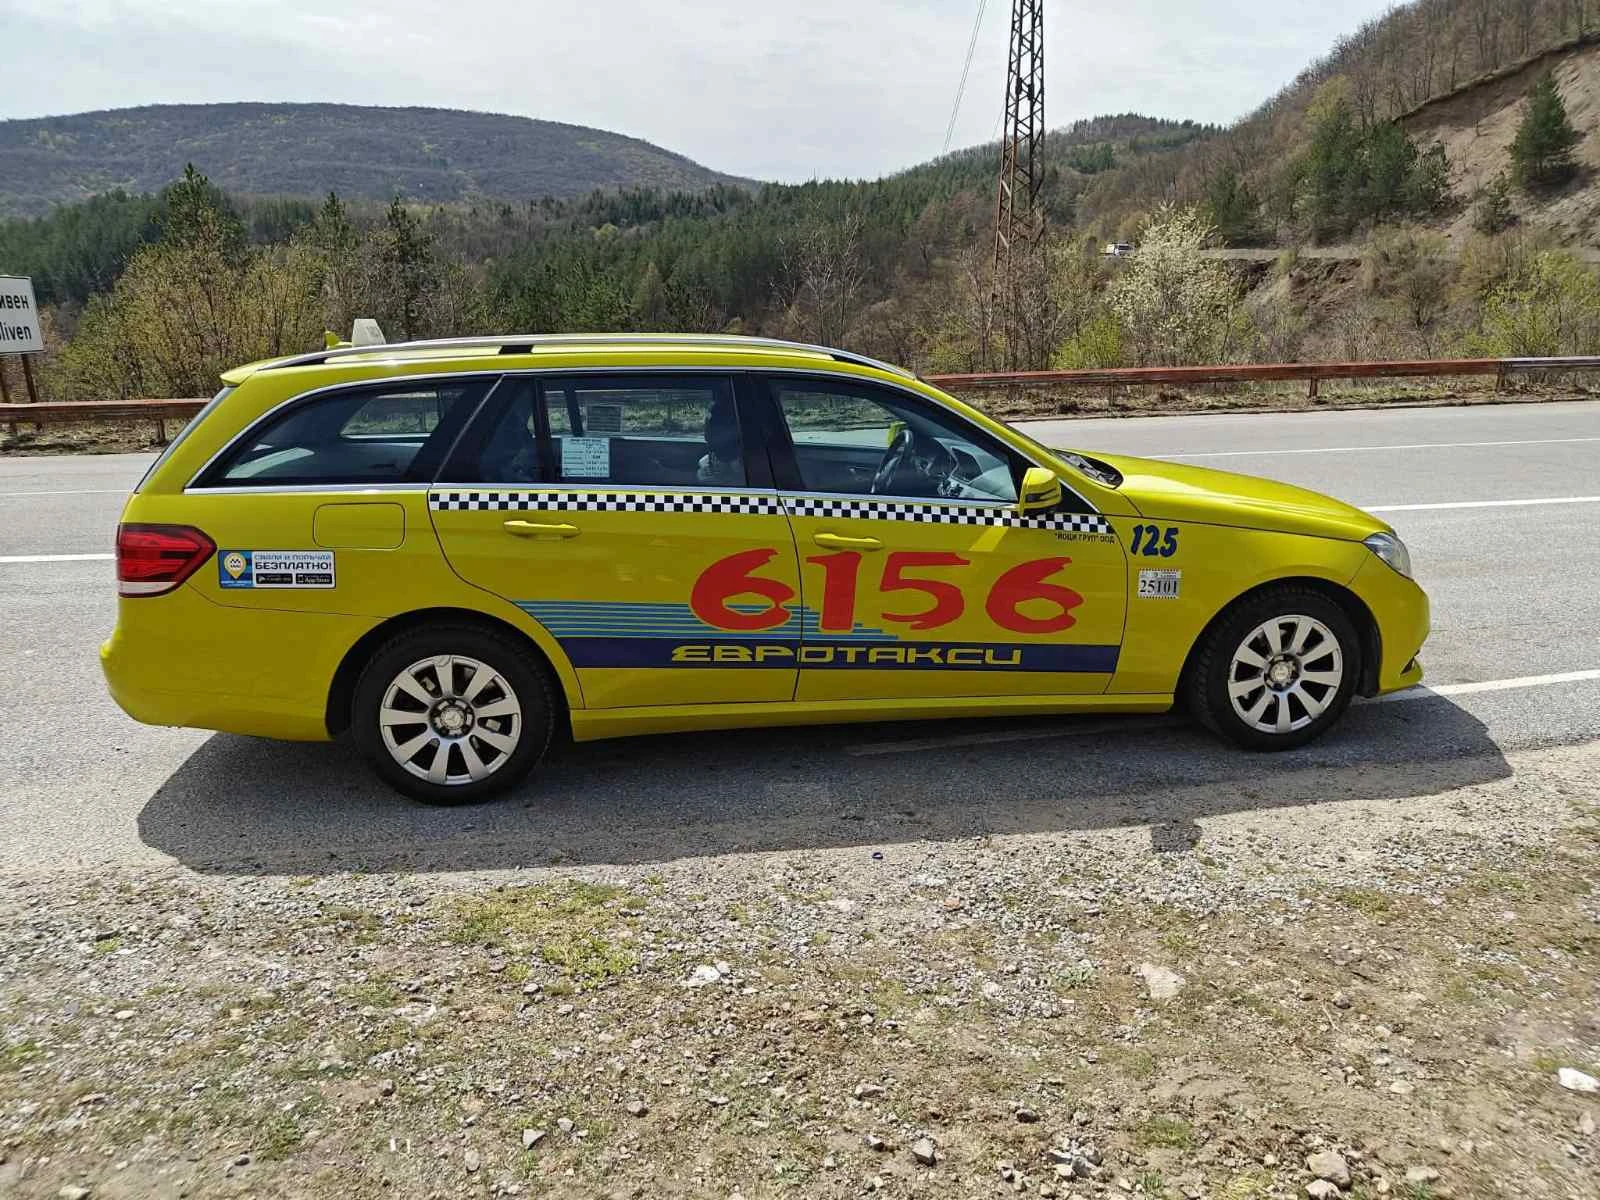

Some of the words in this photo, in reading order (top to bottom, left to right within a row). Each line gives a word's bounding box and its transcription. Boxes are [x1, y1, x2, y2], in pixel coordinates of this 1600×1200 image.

[0, 321, 32, 341] liven
[1130, 524, 1179, 558] 125
[255, 561, 332, 570] БЕЗПЛАТНО!
[688, 548, 1085, 635] 6156
[1139, 579, 1177, 593] 25101
[671, 645, 1023, 666] ЕВРОТАКСИ
